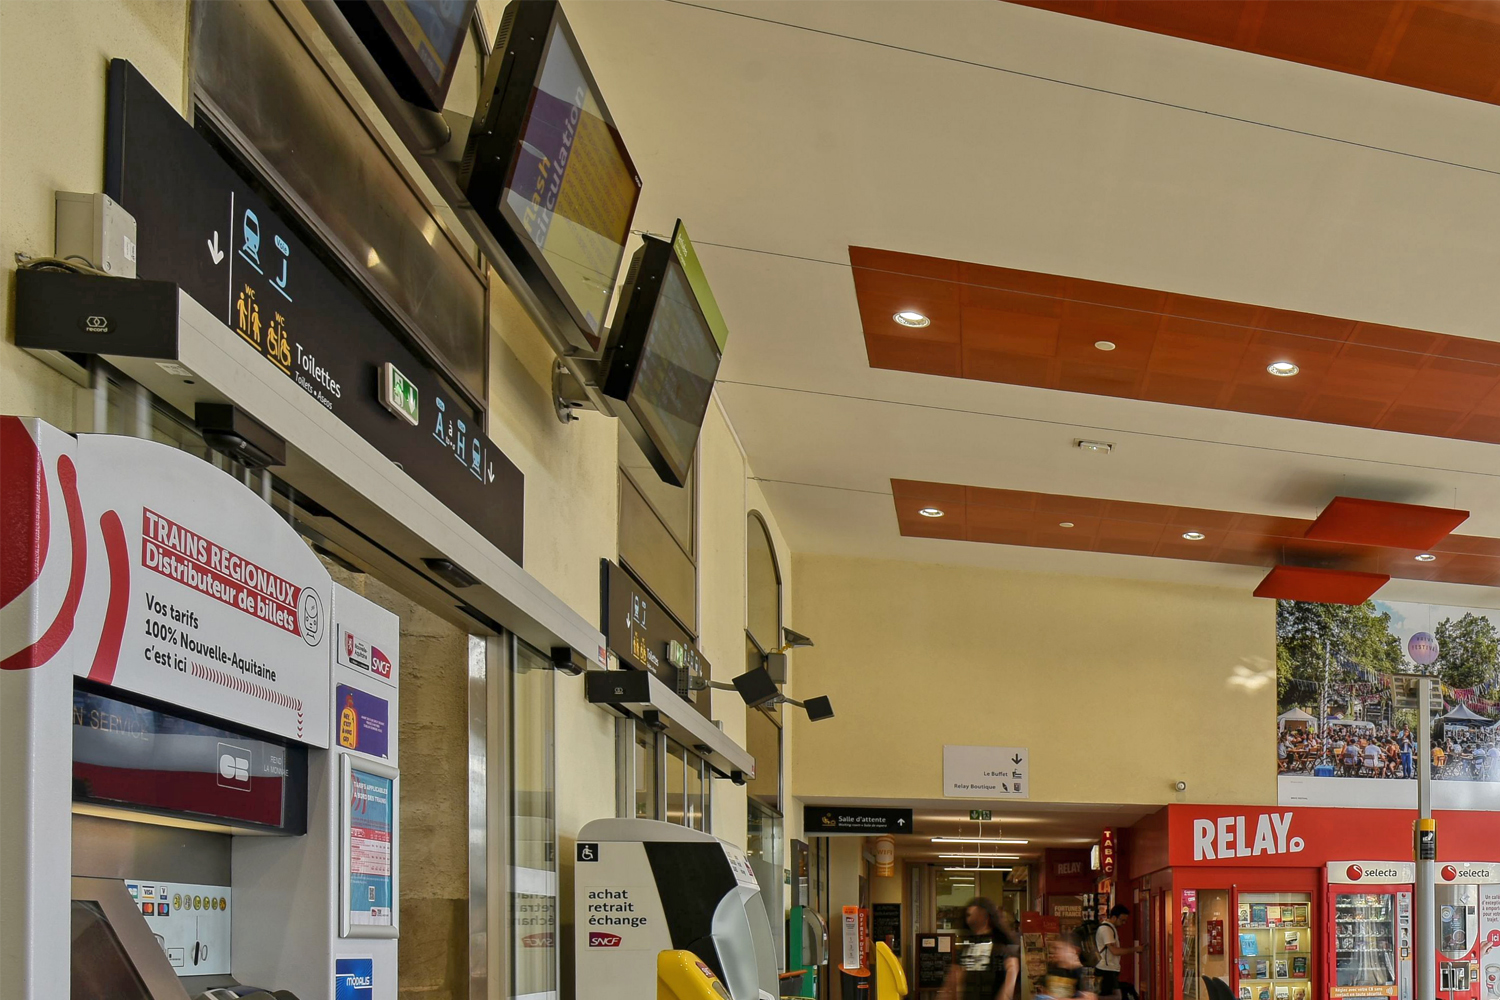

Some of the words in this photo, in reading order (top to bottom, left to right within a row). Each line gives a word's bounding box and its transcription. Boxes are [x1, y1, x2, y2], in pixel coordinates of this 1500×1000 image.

[534, 85, 585, 246] circulation
[276, 259, 287, 288] J
[245, 283, 256, 300] WC
[275, 311, 285, 326] WC
[295, 342, 341, 399] Toilettes
[295, 370, 313, 394] Toilets
[317, 393, 333, 410] Aseos
[435, 412, 444, 439] A
[457, 431, 466, 460] H
[146, 511, 208, 563] TRAINS
[211, 545, 295, 606] RÉGIONAUX
[146, 542, 236, 603] Distributeur
[238, 589, 255, 613] de
[257, 596, 294, 631] billets
[145, 593, 168, 617] Vos
[170, 604, 199, 629] tarifs
[144, 645, 172, 669] c'est
[174, 653, 187, 673] ici
[145, 619, 178, 645] 100%
[180, 631, 277, 682] Nouvelle-Aquitaine
[371, 658, 391, 675] SNCF
[90, 709, 149, 741] SERVICE
[263, 764, 270, 772] LA
[838, 815, 855, 823] Salle
[1193, 812, 1294, 861] RELAY
[1103, 830, 1113, 873] TABAC
[1058, 861, 1081, 875] RELAY
[1364, 866, 1398, 878] selecta
[1458, 869, 1490, 878] selecta
[143, 888, 153, 896] VISA
[588, 888, 629, 900] achat
[588, 900, 634, 912] retrait
[1054, 905, 1082, 913] FORTUNES
[588, 914, 647, 929] échange
[590, 936, 620, 947] SNCF
[346, 976, 370, 986] MODALIS
